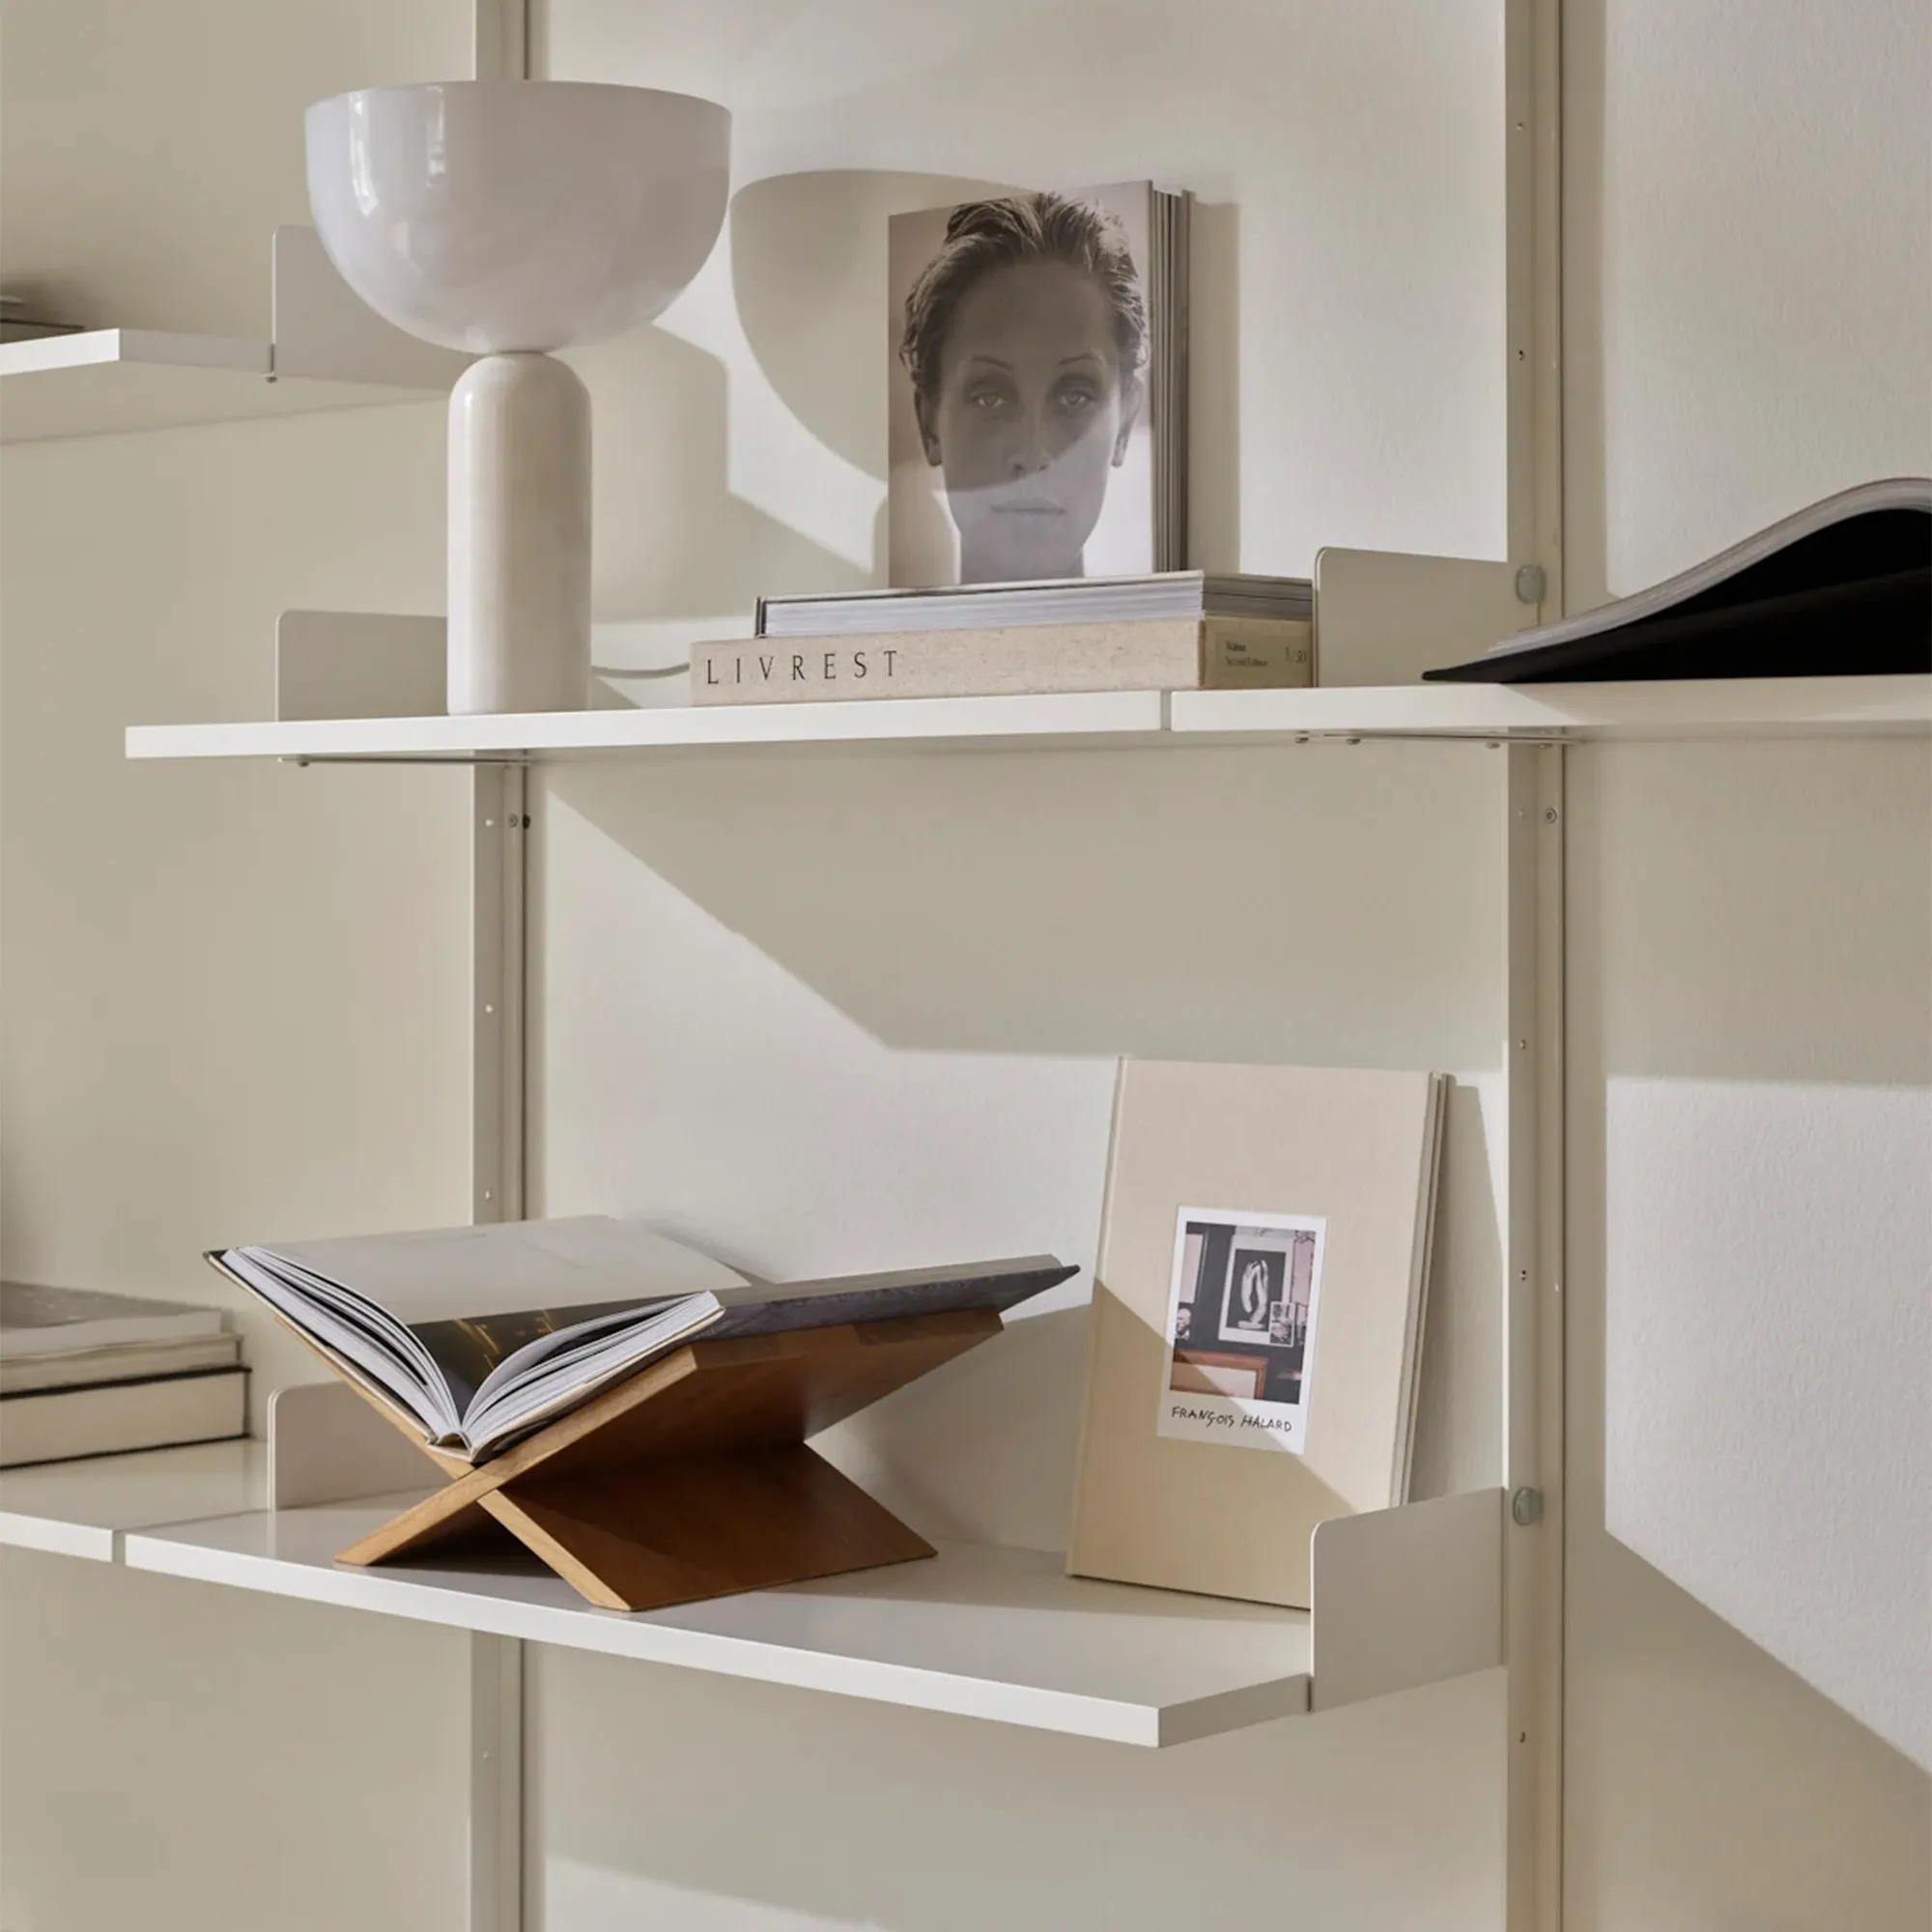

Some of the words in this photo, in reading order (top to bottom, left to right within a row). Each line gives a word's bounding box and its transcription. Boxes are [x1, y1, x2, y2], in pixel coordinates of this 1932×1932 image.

[707, 650, 897, 685] LIVREST
[1171, 1406, 1235, 1429] FRANÇOIS
[1240, 1414, 1293, 1434] HALARD
